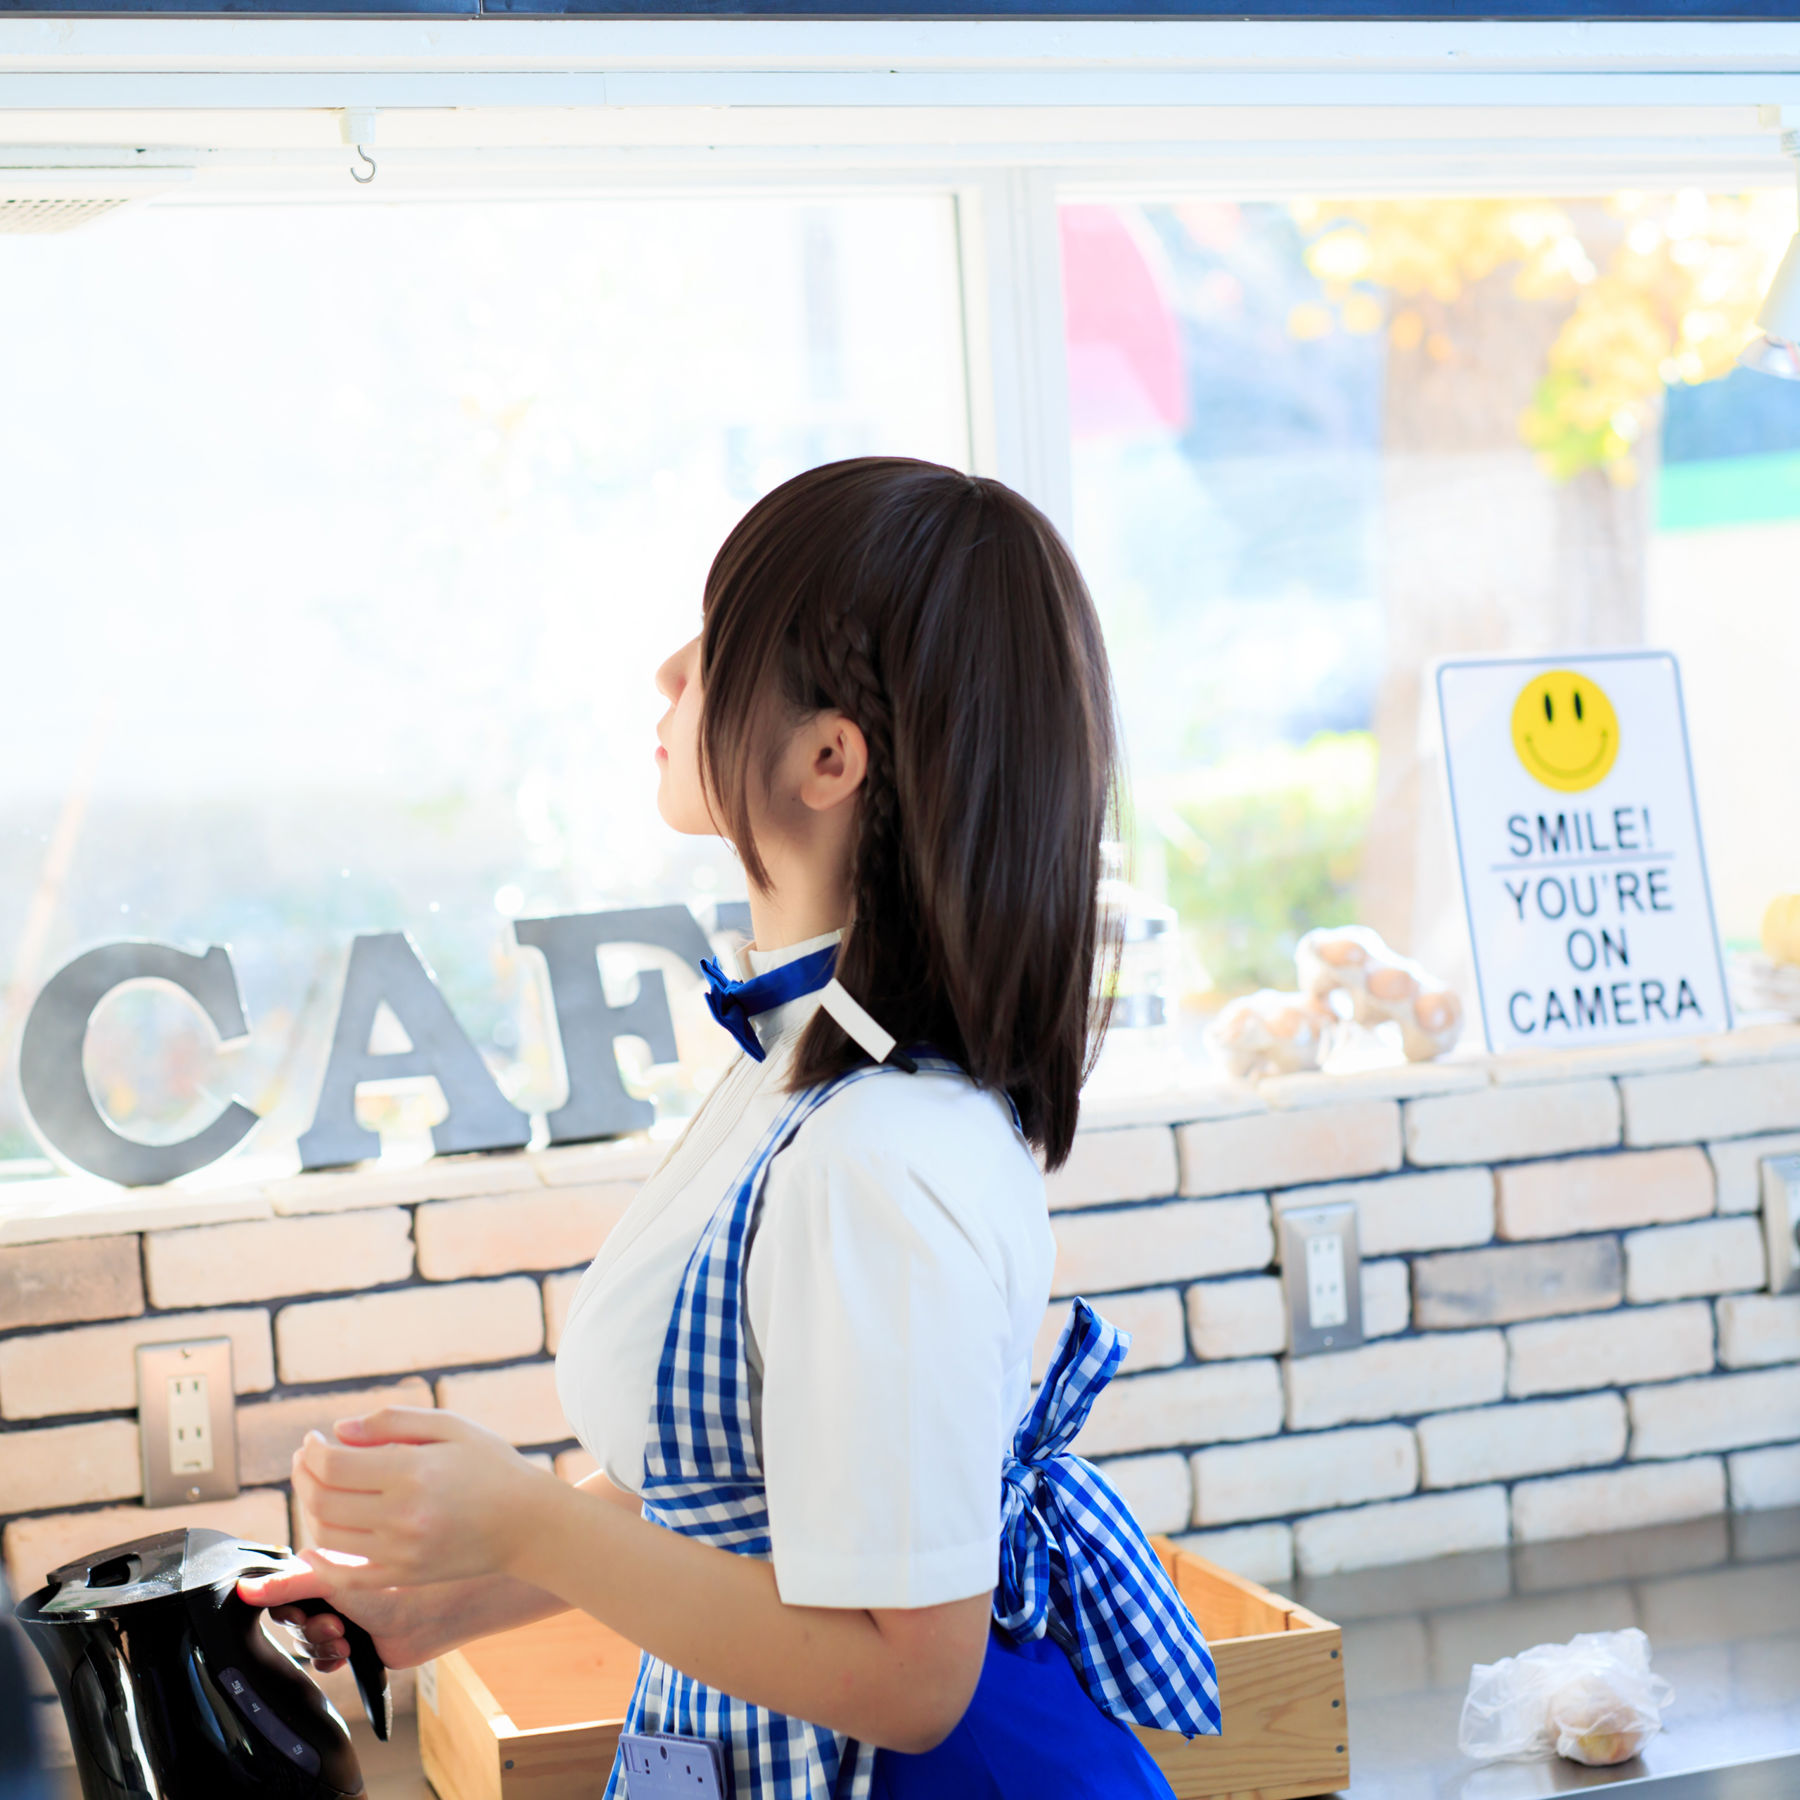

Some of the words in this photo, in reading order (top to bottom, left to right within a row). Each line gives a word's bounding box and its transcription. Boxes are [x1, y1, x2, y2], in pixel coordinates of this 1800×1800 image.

[1507, 806, 1655, 858] SMILE!
[1504, 867, 1675, 922] YOU'RE
[1566, 927, 1630, 973] ON
[1508, 978, 1704, 1035] CAMERA
[19, 901, 752, 1187] CAF
